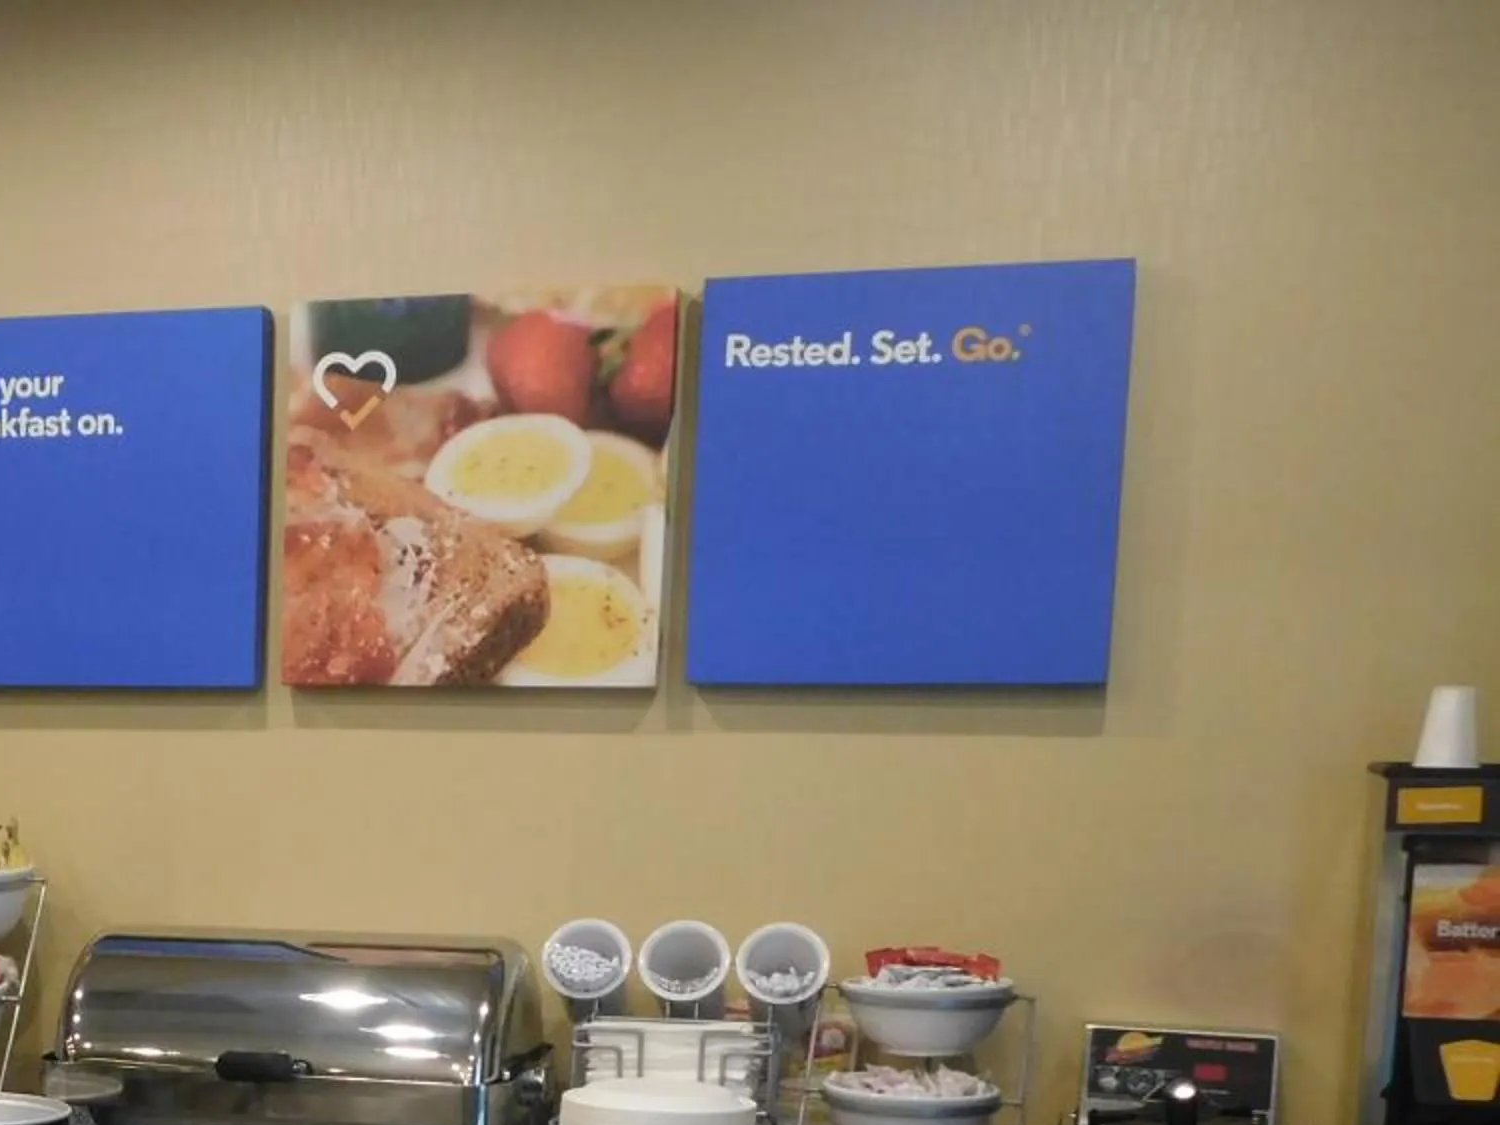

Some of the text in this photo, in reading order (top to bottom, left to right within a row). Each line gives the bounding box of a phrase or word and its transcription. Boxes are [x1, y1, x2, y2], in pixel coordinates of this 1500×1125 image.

[725, 331, 861, 367] Rested.
[870, 330, 942, 364] Set.
[77, 413, 124, 436] on.
